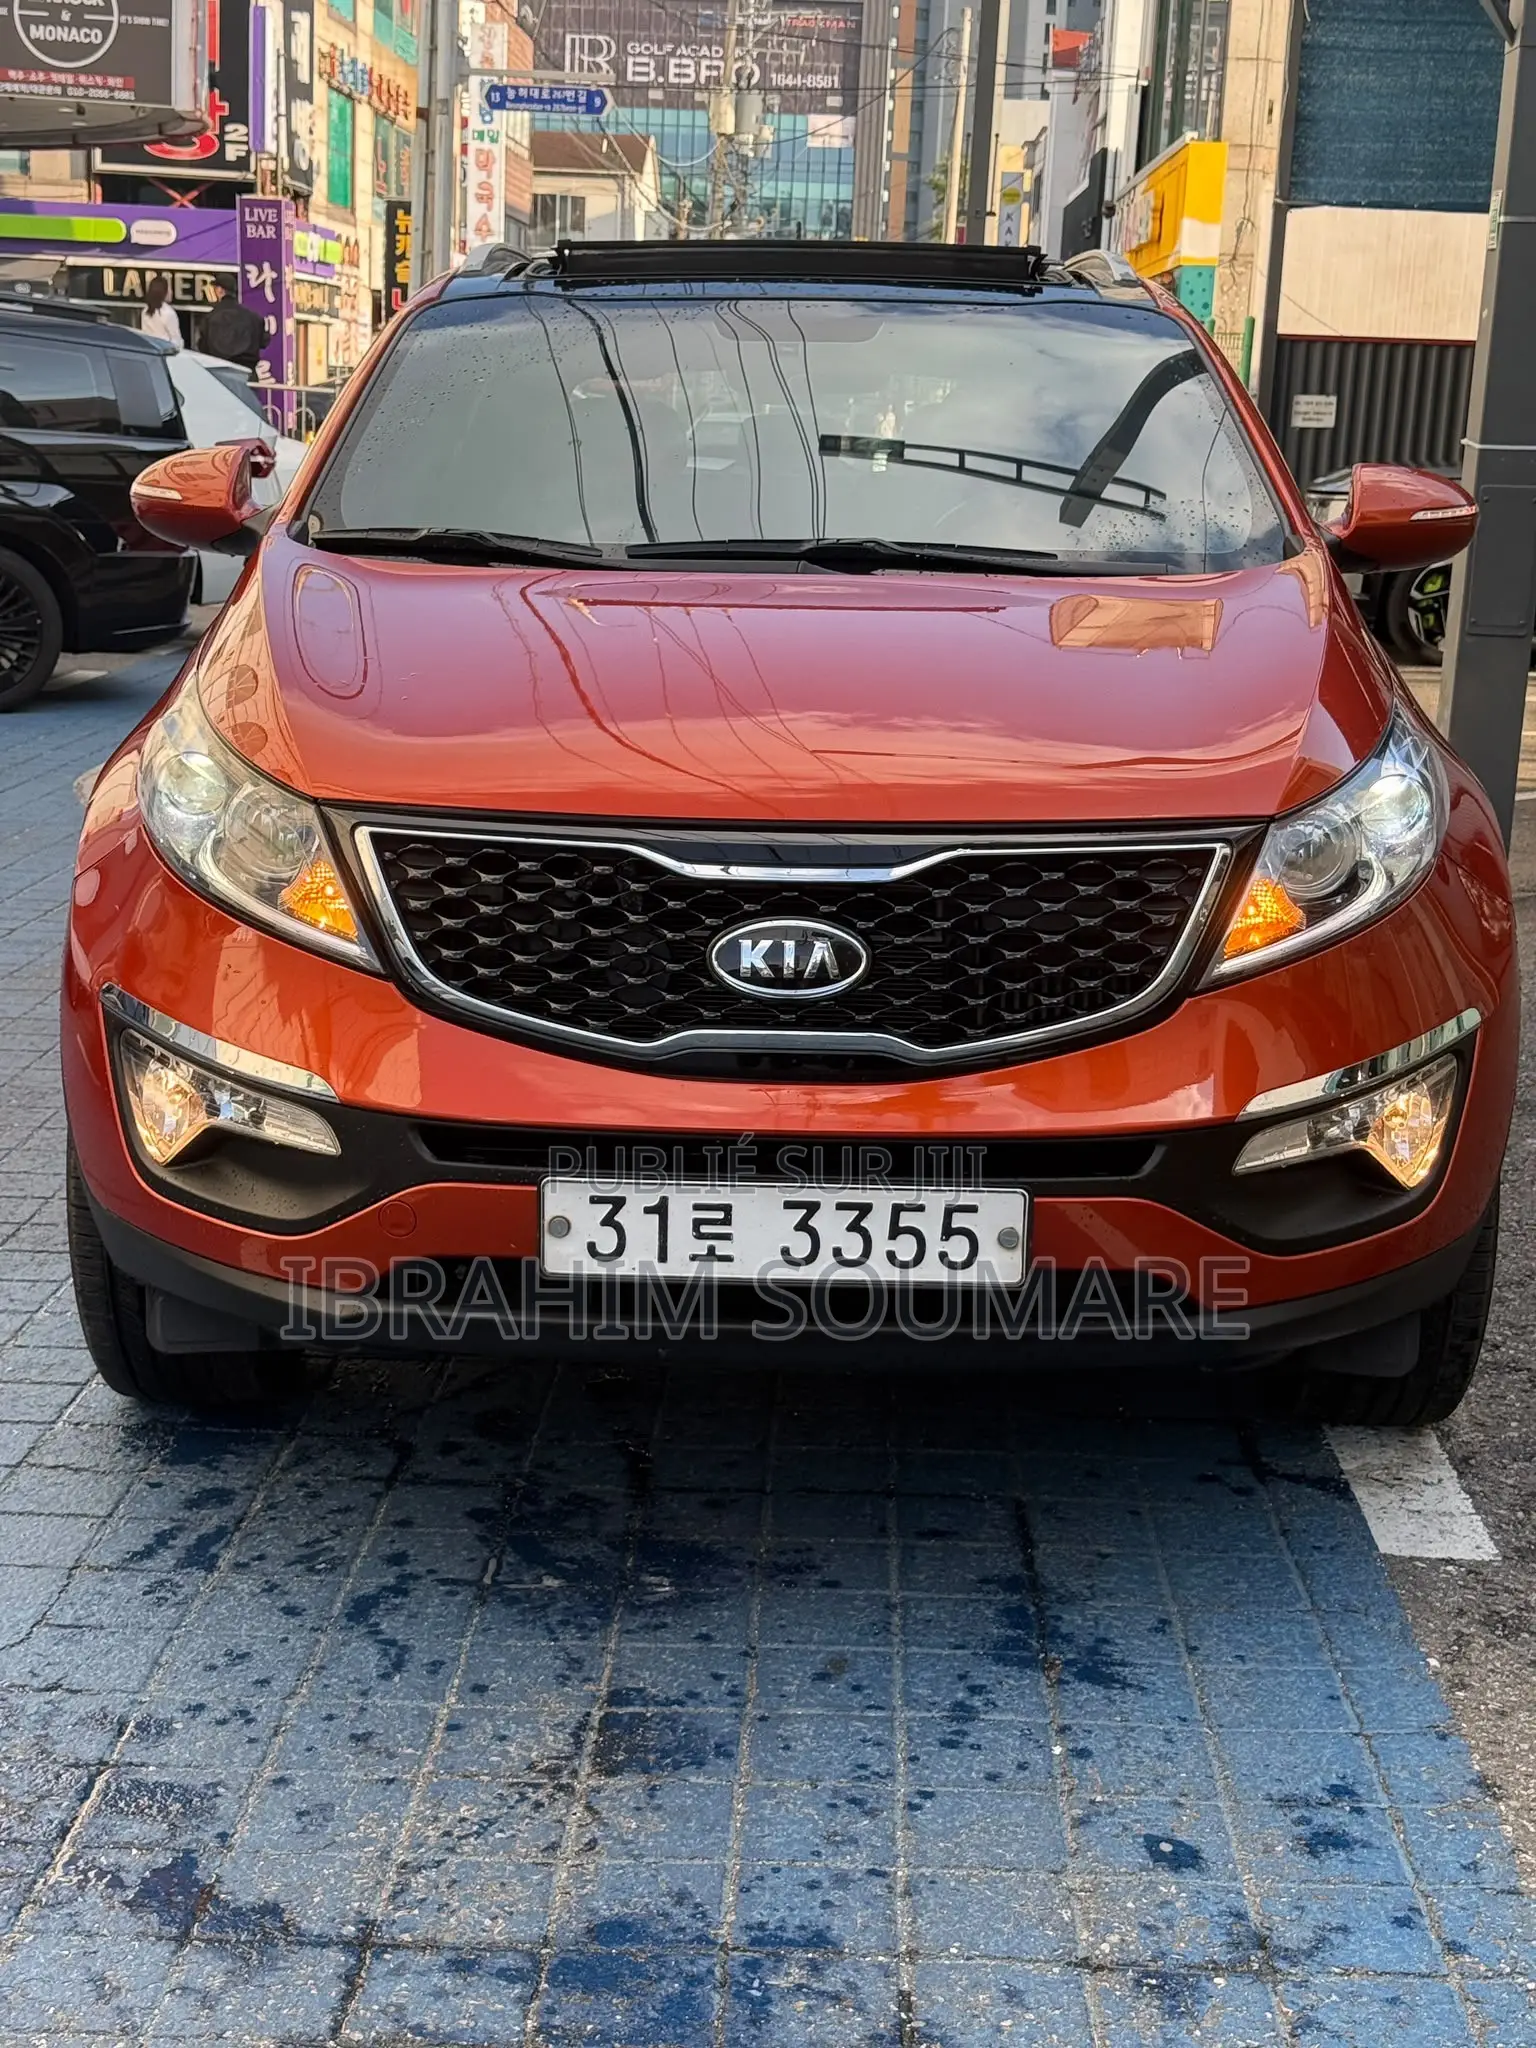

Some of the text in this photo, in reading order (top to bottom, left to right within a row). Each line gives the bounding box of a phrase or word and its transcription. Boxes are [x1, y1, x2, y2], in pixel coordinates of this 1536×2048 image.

[29, 24, 103, 44] MONACO
[626, 42, 759, 59] GOLF ACADMY
[224, 123, 249, 162] 2F
[244, 207, 278, 223] LIVE
[246, 224, 276, 239] BAR
[738, 939, 841, 979] KIA
[586, 1195, 980, 1271] 31로 3355
